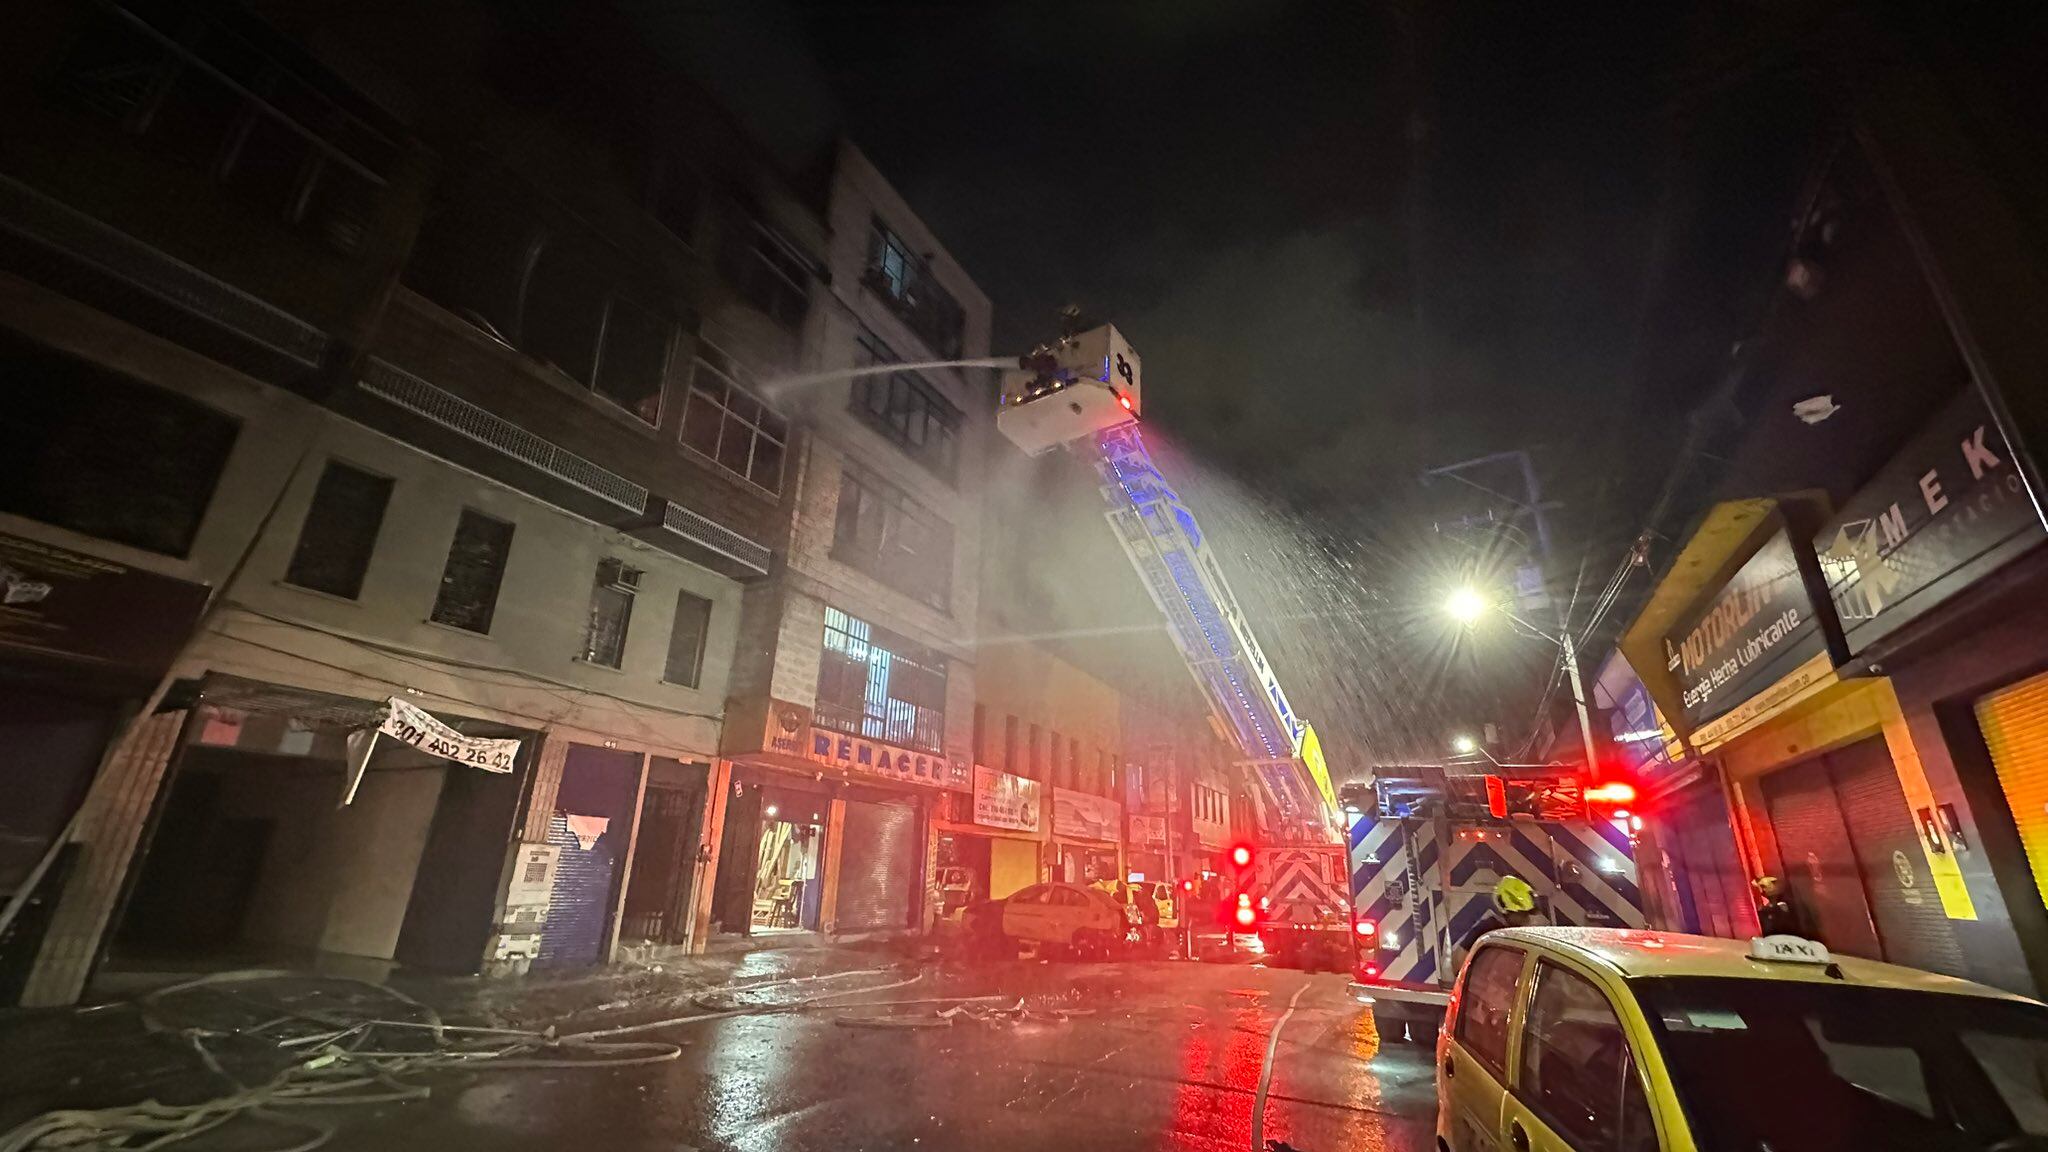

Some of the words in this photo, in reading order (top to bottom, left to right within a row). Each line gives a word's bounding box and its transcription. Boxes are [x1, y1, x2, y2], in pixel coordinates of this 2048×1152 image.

[1736, 607, 1801, 668] Lubricante
[465, 748, 487, 764] 26
[492, 752, 511, 770] 42
[815, 734, 943, 780] RENACER
[1770, 942, 1816, 957] TAXI
